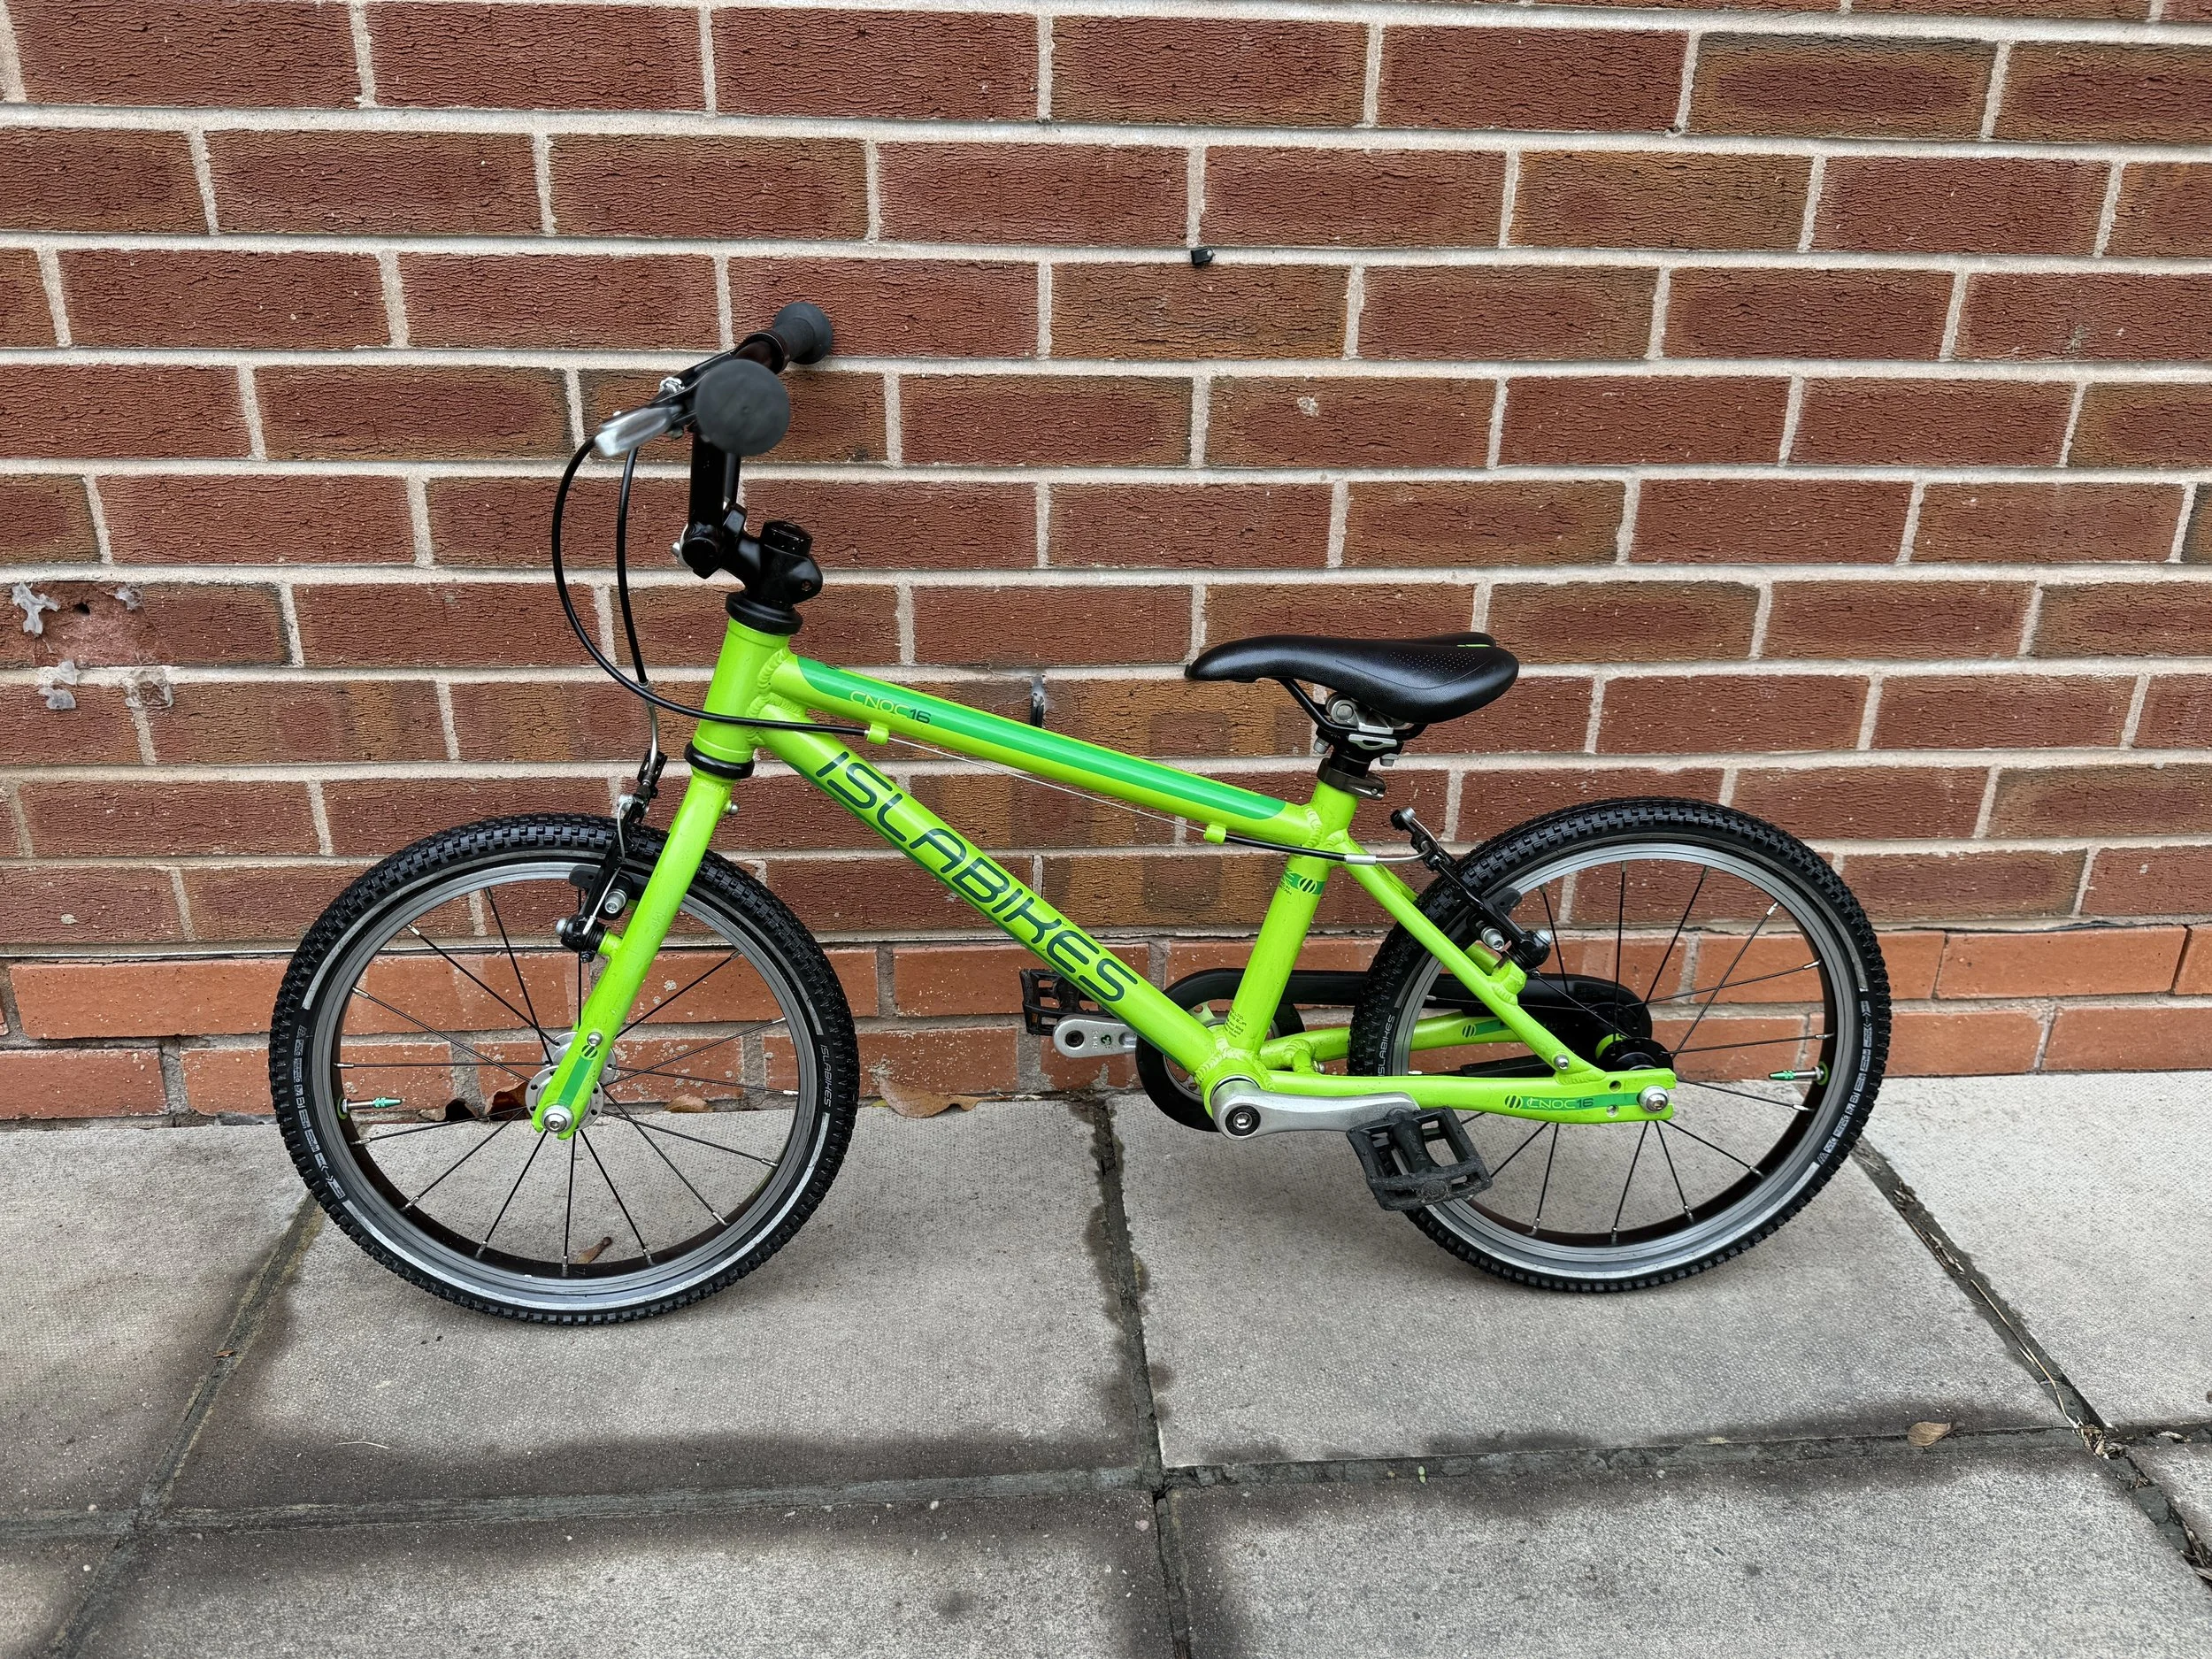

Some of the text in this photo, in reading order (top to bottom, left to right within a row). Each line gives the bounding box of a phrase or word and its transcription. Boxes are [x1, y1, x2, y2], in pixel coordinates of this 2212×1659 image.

[850, 691, 932, 724] CNOC16
[816, 751, 1138, 1002] ISLABIKES
[820, 1044, 833, 1108] ISLABIKES
[1526, 1098, 1594, 1110] CNOC16
